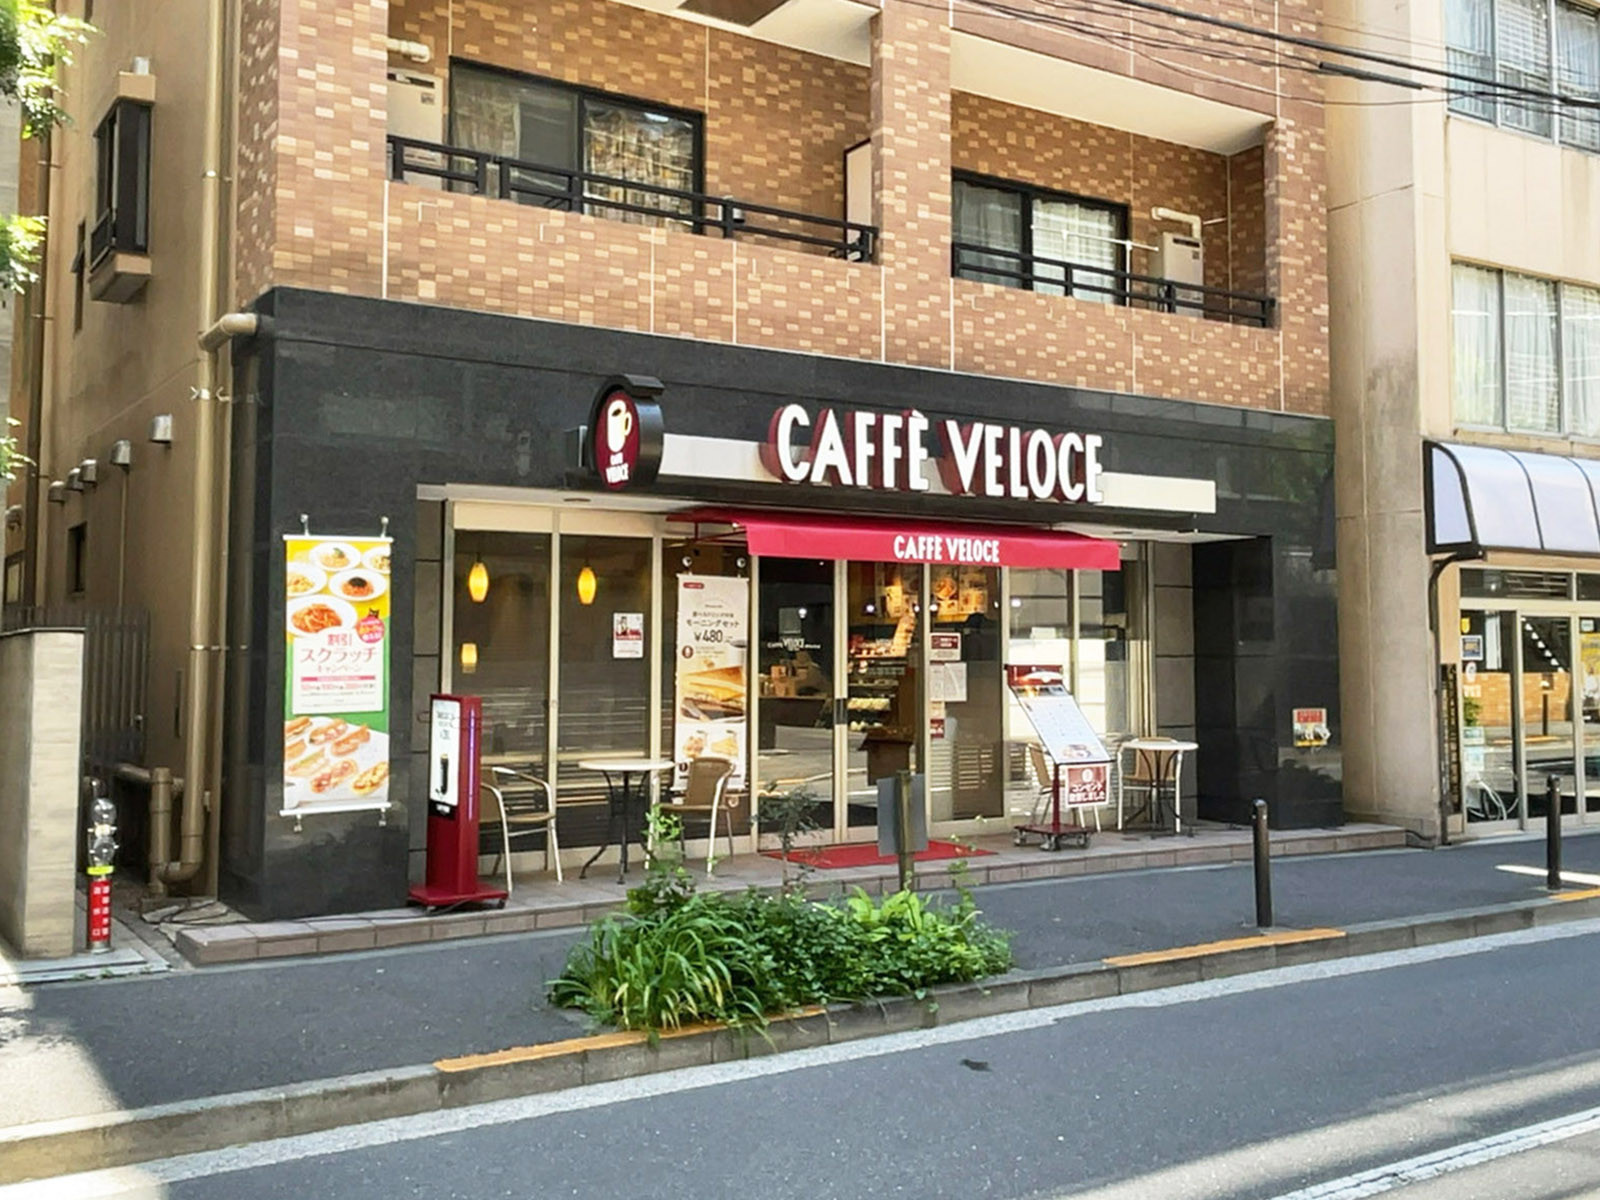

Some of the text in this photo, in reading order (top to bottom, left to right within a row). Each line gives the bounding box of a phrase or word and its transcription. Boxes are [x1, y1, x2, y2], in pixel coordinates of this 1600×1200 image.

[776, 404, 1103, 503] CAFFÈ VELOCE
[893, 535, 1000, 563] CAFFÈ VELOCE
[300, 647, 377, 664] スクラッチ
